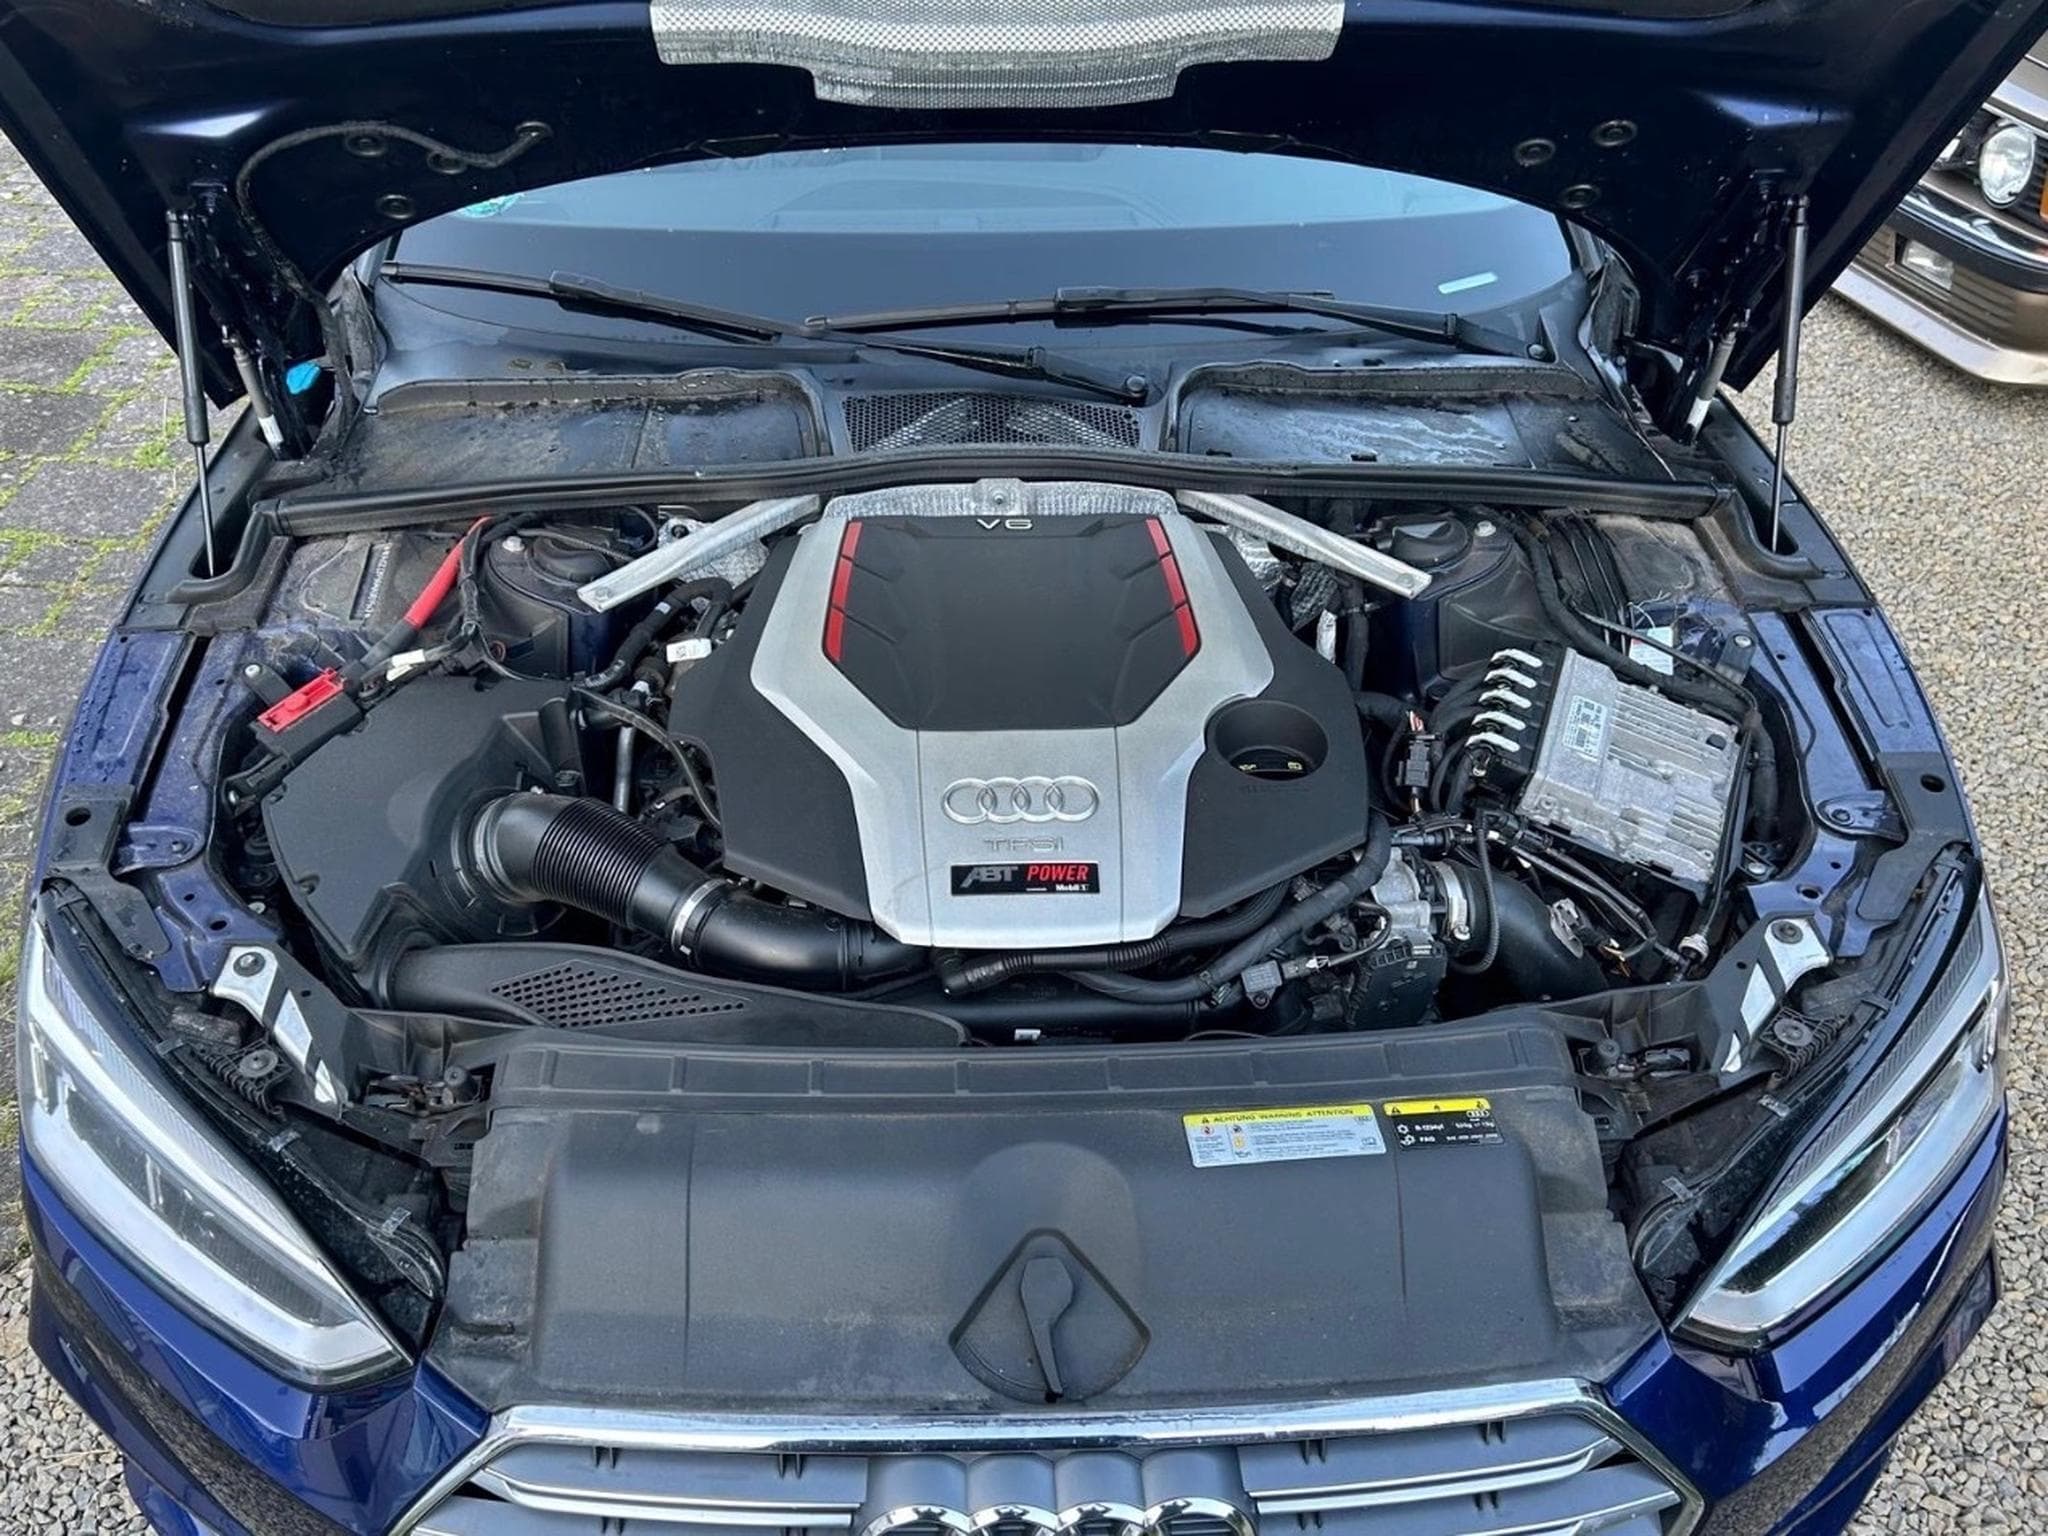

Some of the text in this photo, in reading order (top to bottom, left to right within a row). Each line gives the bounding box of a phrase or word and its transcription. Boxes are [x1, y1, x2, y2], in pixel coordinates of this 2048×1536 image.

[976, 518, 1033, 530] V6
[984, 836, 1064, 852] TFSI
[960, 864, 1089, 888] ABT POWER
[1213, 1113, 1256, 1124] ACHTUNG
[1306, 1108, 1354, 1117] ATTENTION
